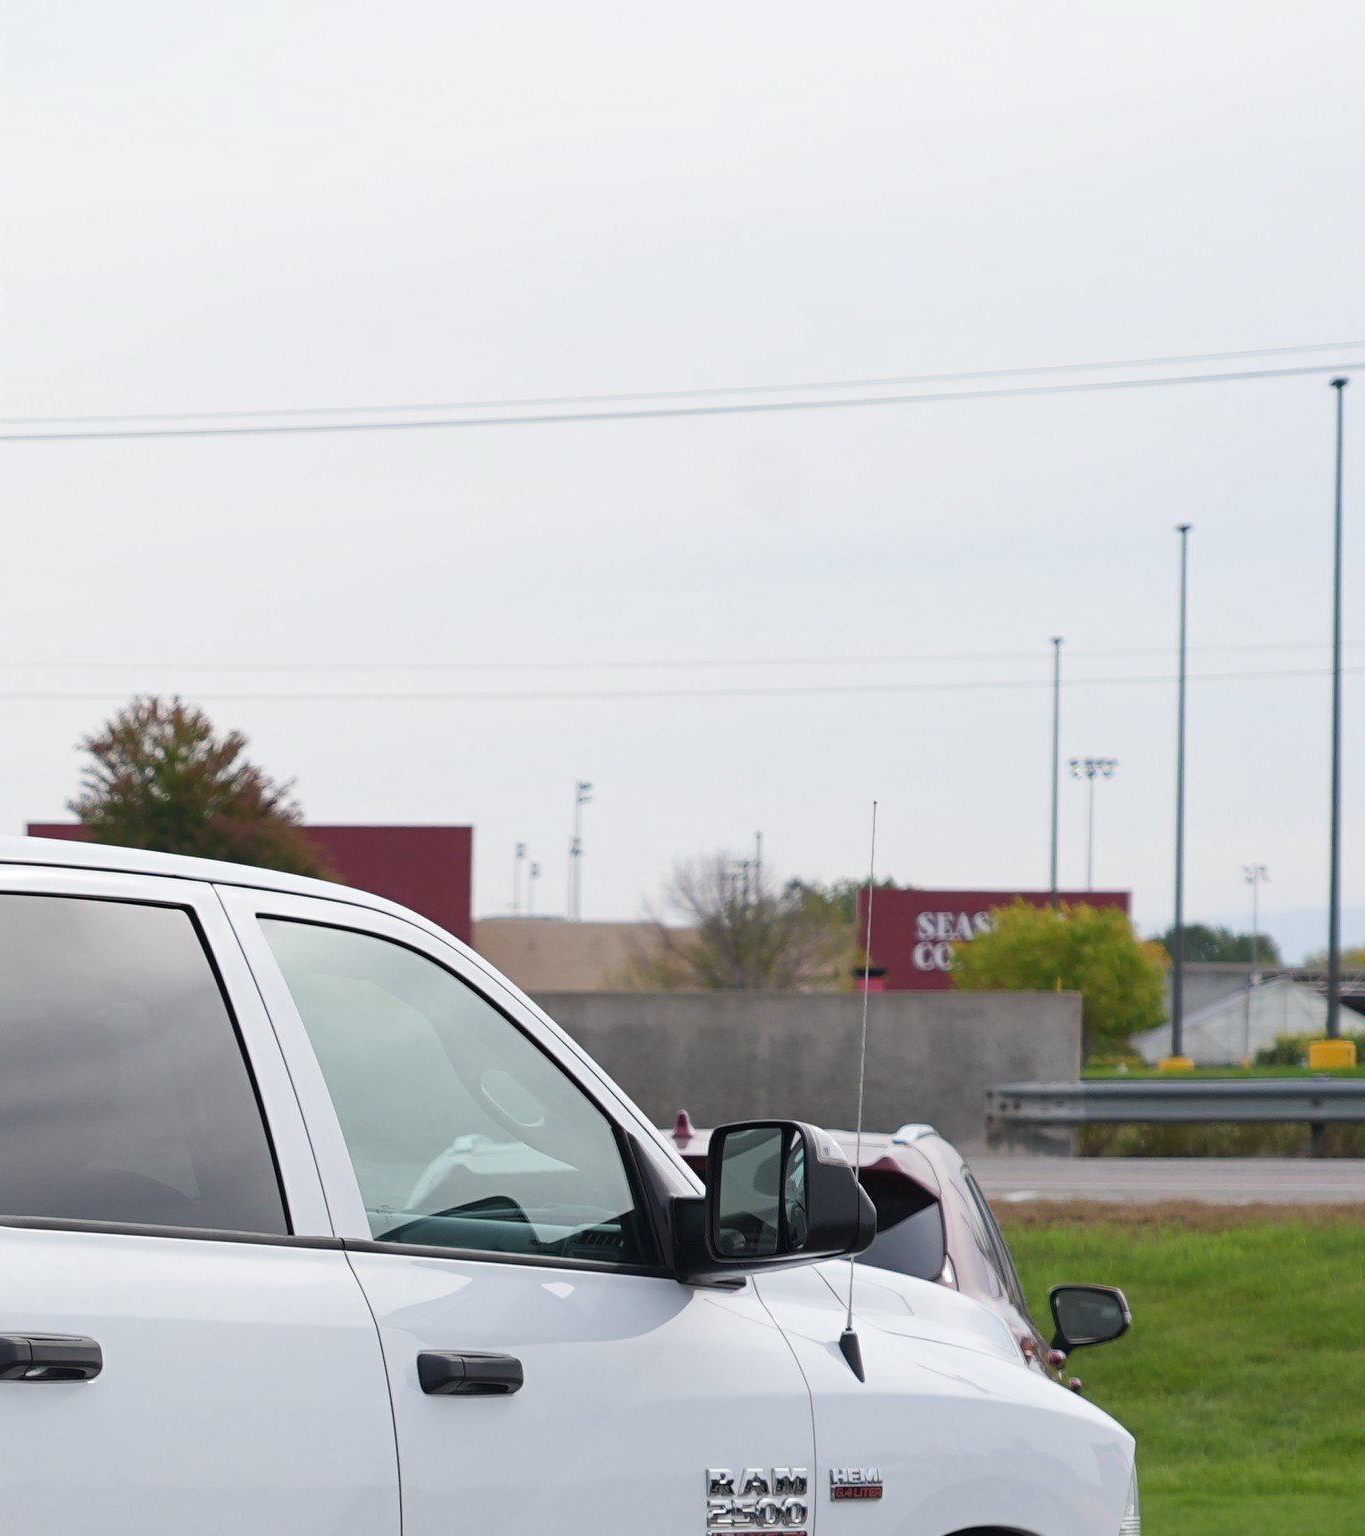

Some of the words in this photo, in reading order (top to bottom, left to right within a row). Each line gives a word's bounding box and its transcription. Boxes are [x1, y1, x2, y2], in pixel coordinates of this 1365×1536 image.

[706, 1467, 808, 1496] RAM
[830, 1467, 883, 1485] HEMI
[854, 1486, 882, 1498] LITER
[707, 1497, 808, 1528] 2500
